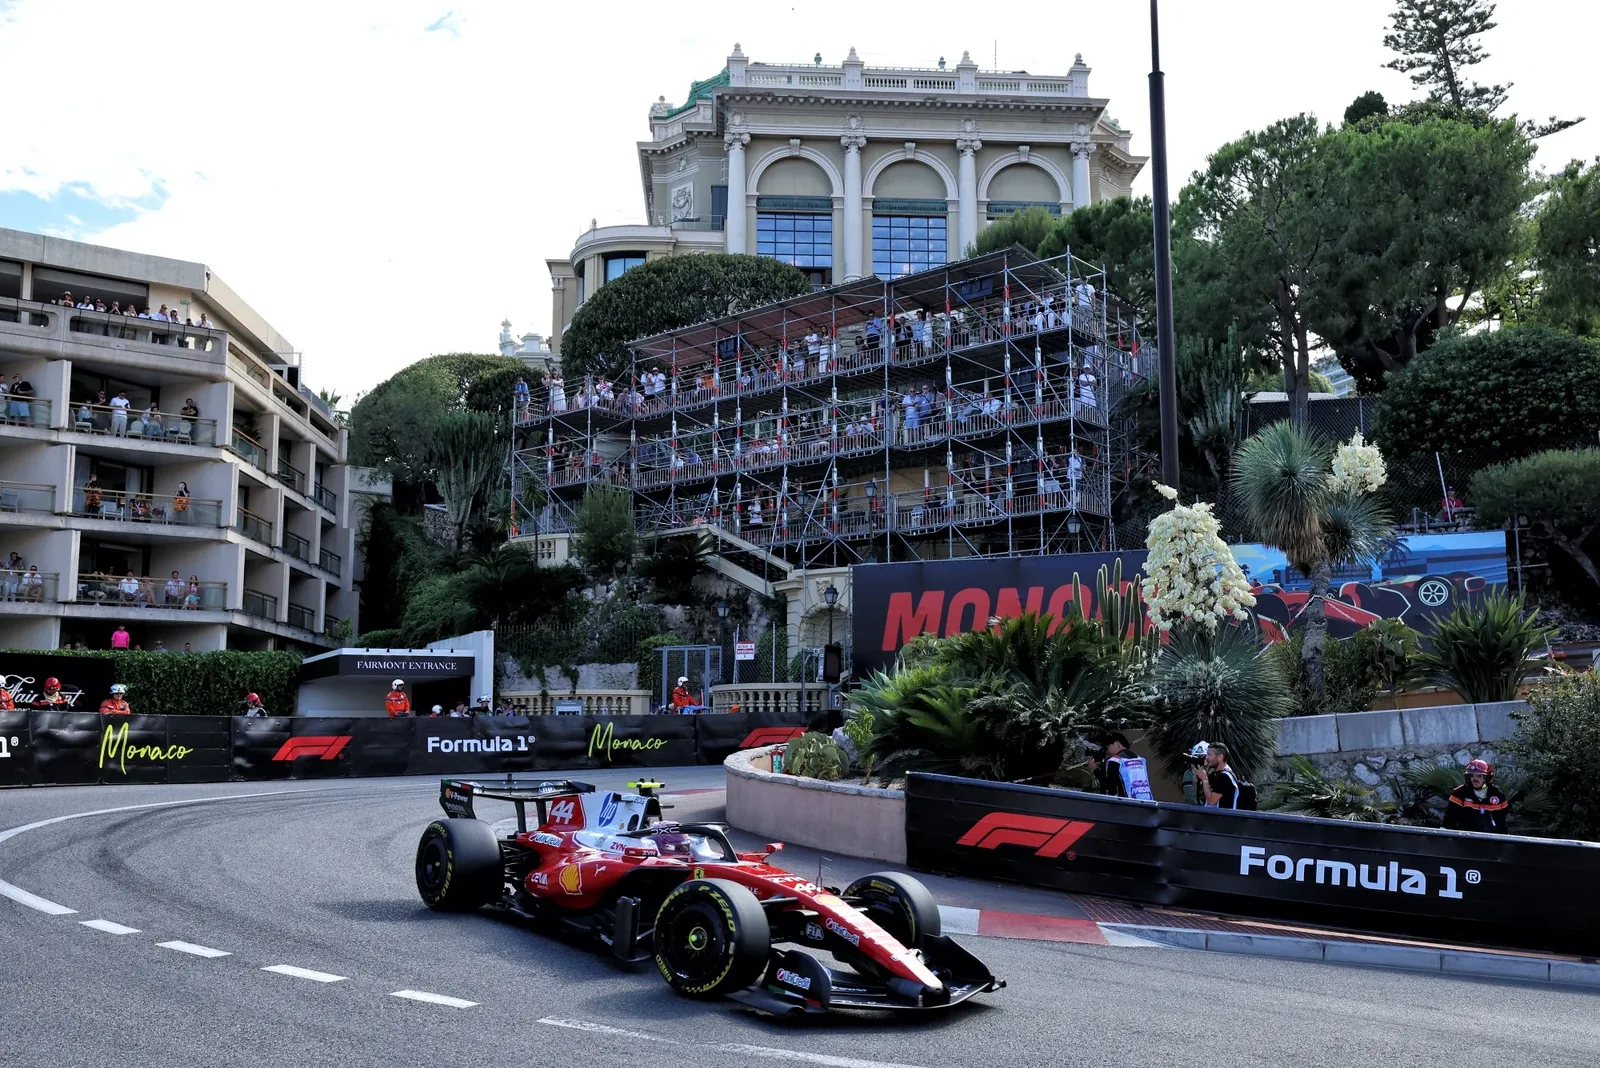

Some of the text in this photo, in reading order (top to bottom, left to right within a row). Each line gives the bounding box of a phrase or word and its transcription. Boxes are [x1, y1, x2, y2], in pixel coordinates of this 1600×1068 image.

[357, 661, 457, 671] FAIRMONT ENTRANCE
[99, 722, 193, 775] Monaco
[427, 736, 513, 753] Formula
[588, 721, 668, 761] Monaco
[551, 800, 573, 825] 44
[600, 793, 618, 828] hp
[1239, 845, 1426, 895] Formula
[709, 891, 737, 932] ZERO
[806, 926, 822, 938] FIA
